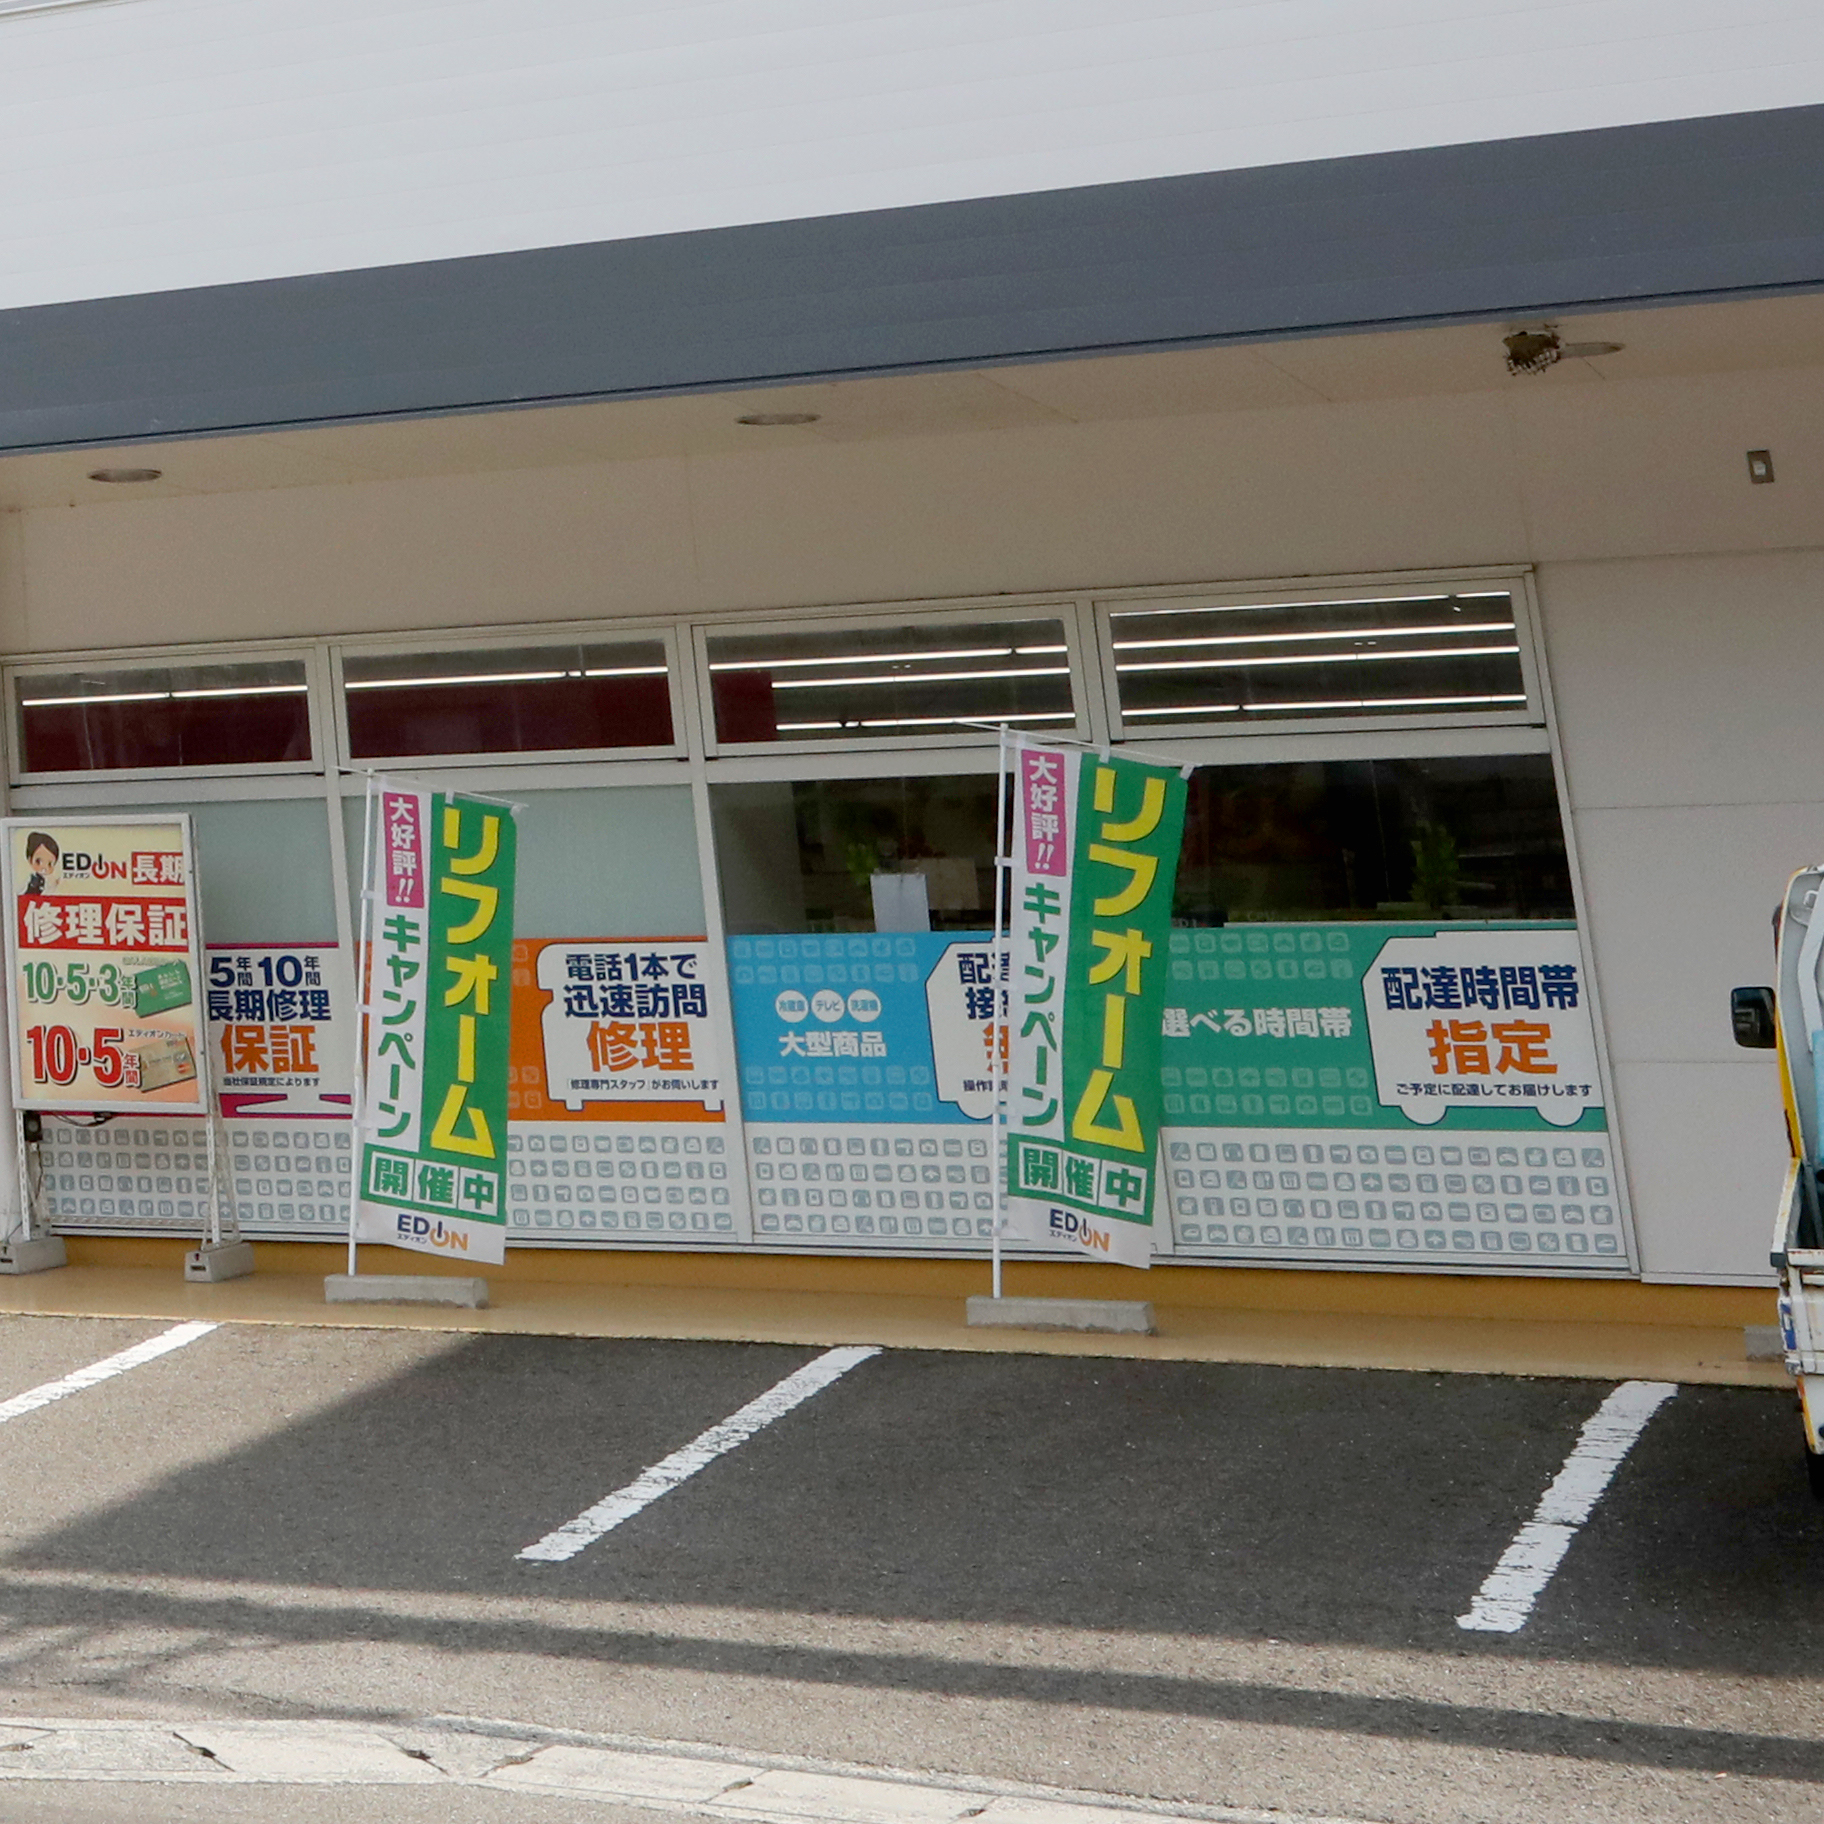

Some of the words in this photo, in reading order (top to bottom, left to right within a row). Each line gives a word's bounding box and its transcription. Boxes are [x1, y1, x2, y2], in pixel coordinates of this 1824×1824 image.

[62, 853, 128, 879] EDION
[23, 900, 188, 946] 修理保証
[430, 806, 500, 1159] リフォーム
[565, 952, 698, 981] 電話1本で
[1072, 767, 1167, 1154] リフォーム
[207, 989, 332, 1022] 長期修理
[563, 984, 708, 1018] 迅速訪問
[815, 999, 842, 1012] テレビ
[1021, 882, 1061, 1126] キャンペーン
[1381, 964, 1579, 1010] 配達時間帯
[377, 914, 421, 1138] キャンペーン
[778, 1030, 887, 1057] 大型商品
[1161, 1006, 1352, 1038] 選べる時間帯
[220, 1024, 319, 1074] 保証
[586, 1020, 695, 1072] 修理
[1425, 1019, 1558, 1075] 指定
[374, 1156, 495, 1210] 開催中
[1023, 1147, 1143, 1208] 開催中
[397, 1214, 469, 1251] EDION
[1049, 1208, 1110, 1252] EDION
